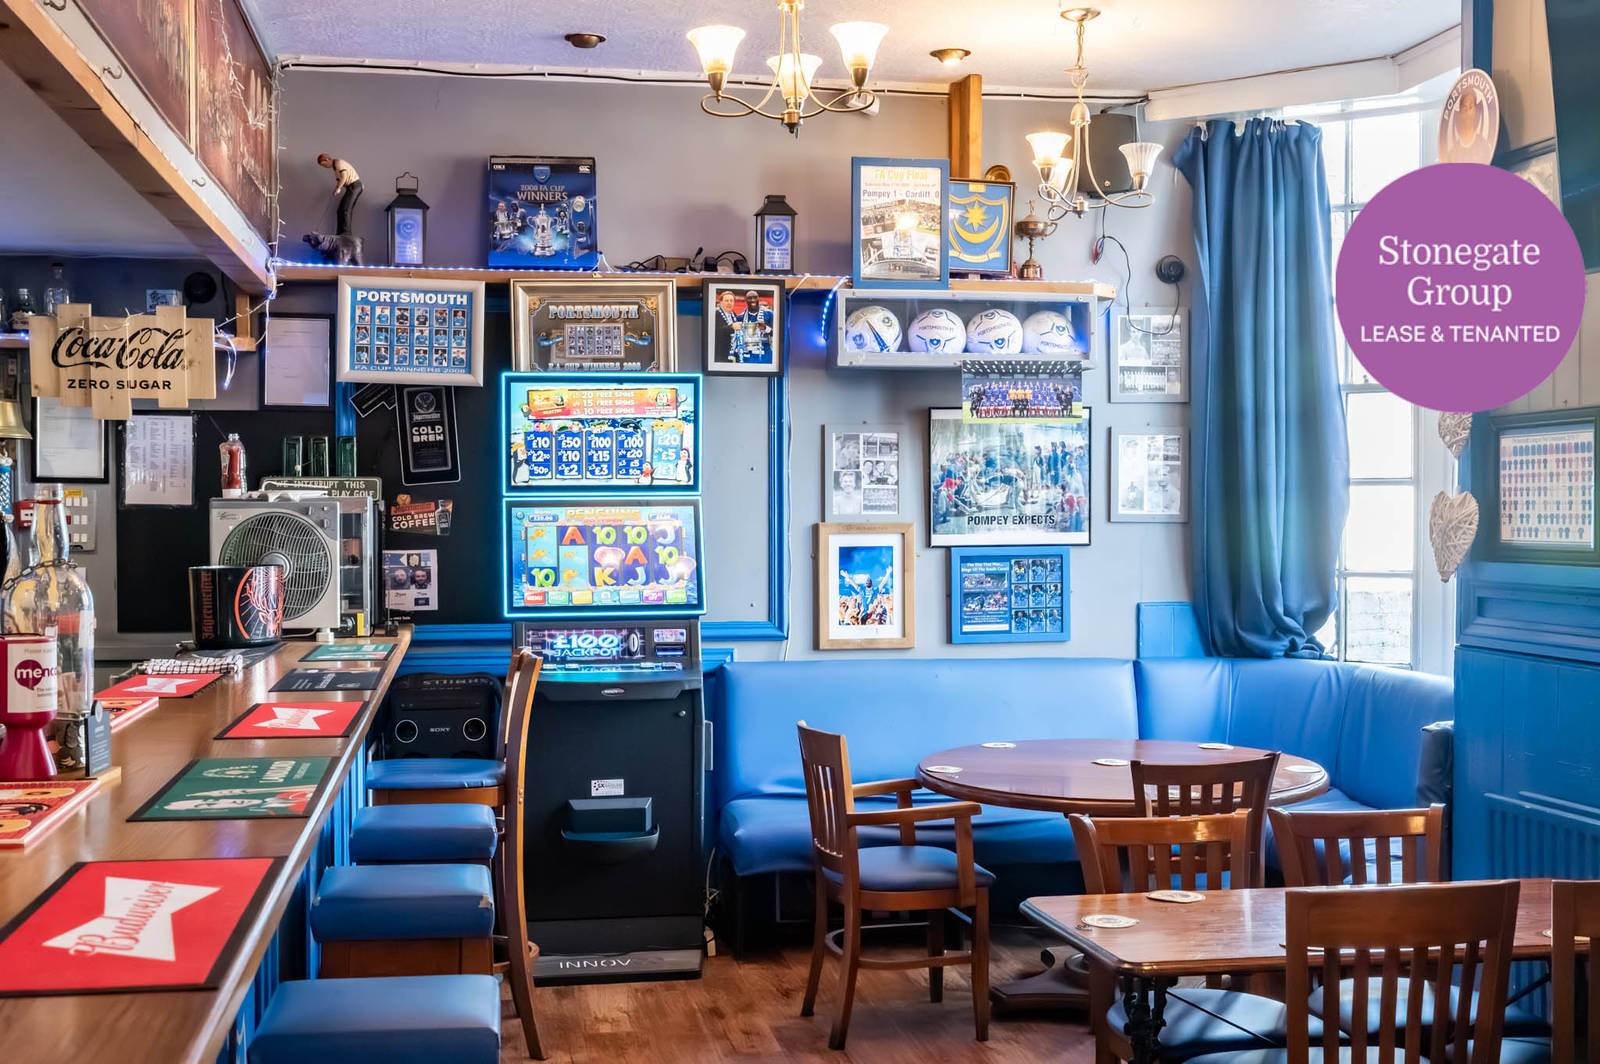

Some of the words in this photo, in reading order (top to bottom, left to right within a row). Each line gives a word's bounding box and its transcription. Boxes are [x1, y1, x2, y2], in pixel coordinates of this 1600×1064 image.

[1443, 75, 1494, 121] PORTSMOUTH
[517, 191, 568, 201] WINNERS
[862, 189, 890, 199] Pompey
[905, 190, 930, 198] Cardiff
[356, 290, 468, 305] PORTSMOUTH
[548, 304, 640, 320] PORTSMOUTH
[51, 327, 192, 370] Coca-Cola
[67, 379, 110, 390] ZERO
[116, 379, 172, 390] SUGAR
[412, 425, 443, 435] COLD
[412, 433, 444, 443] BREW
[532, 437, 550, 448] £10
[561, 436, 580, 448] £50
[591, 436, 611, 448] £100
[624, 436, 643, 448] £100
[657, 434, 680, 446] £20
[562, 450, 580, 462] £10
[592, 450, 610, 462] £15
[627, 449, 643, 458] £20
[661, 449, 676, 461] £5
[563, 465, 578, 476] £2
[594, 465, 608, 475] £3
[344, 480, 366, 489] THIS
[331, 490, 350, 498] PLAY
[392, 514, 412, 522] COLD
[413, 512, 435, 520] BREW
[967, 515, 1009, 526] POMPEY
[1012, 514, 1055, 525] EXPECTS
[392, 517, 436, 530] COFFEE
[561, 526, 586, 544] A
[592, 526, 616, 545] 10
[623, 526, 648, 545] 10
[656, 525, 676, 545] J
[624, 546, 648, 565] A
[655, 546, 678, 564] 10
[531, 568, 556, 587] 10
[594, 567, 616, 586] K
[628, 566, 646, 585] J
[553, 634, 619, 649] £100
[554, 647, 619, 657] JACKPOT
[69, 880, 177, 957] Budweiser
[559, 958, 632, 969] INNOV
